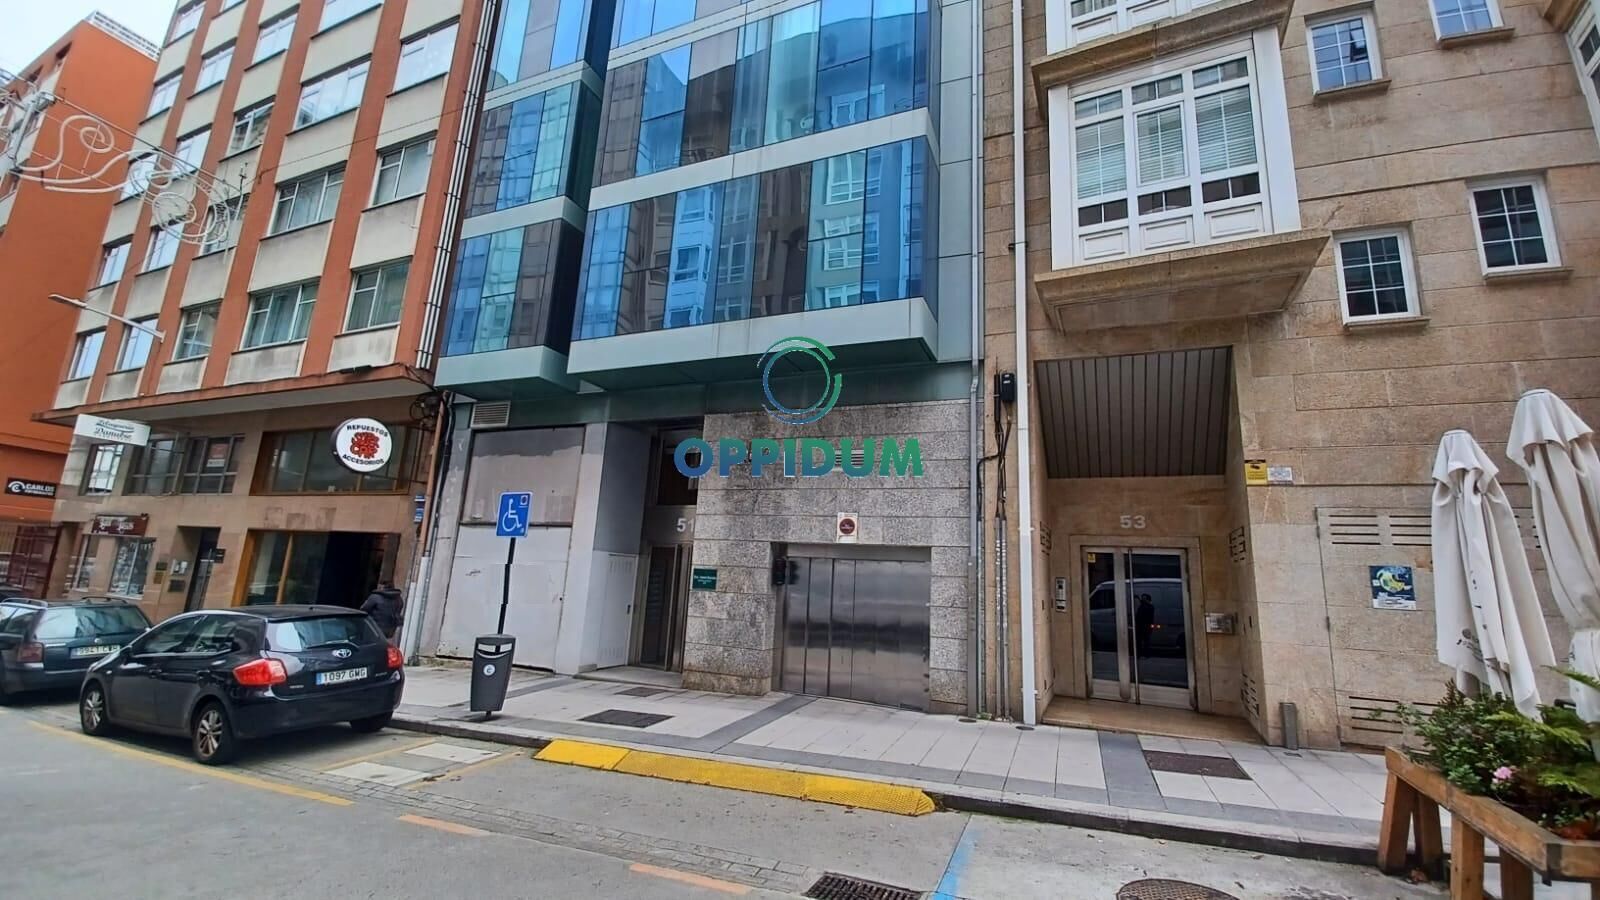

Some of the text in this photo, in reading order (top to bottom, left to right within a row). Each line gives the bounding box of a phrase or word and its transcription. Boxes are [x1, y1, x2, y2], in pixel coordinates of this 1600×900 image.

[346, 424, 389, 437] REPUESTOS
[342, 453, 385, 466] ACCESORIOS
[25, 483, 55, 491] CARLOS
[676, 517, 695, 533] 51
[1120, 515, 1146, 529] 53
[324, 672, 346, 682] 1097
